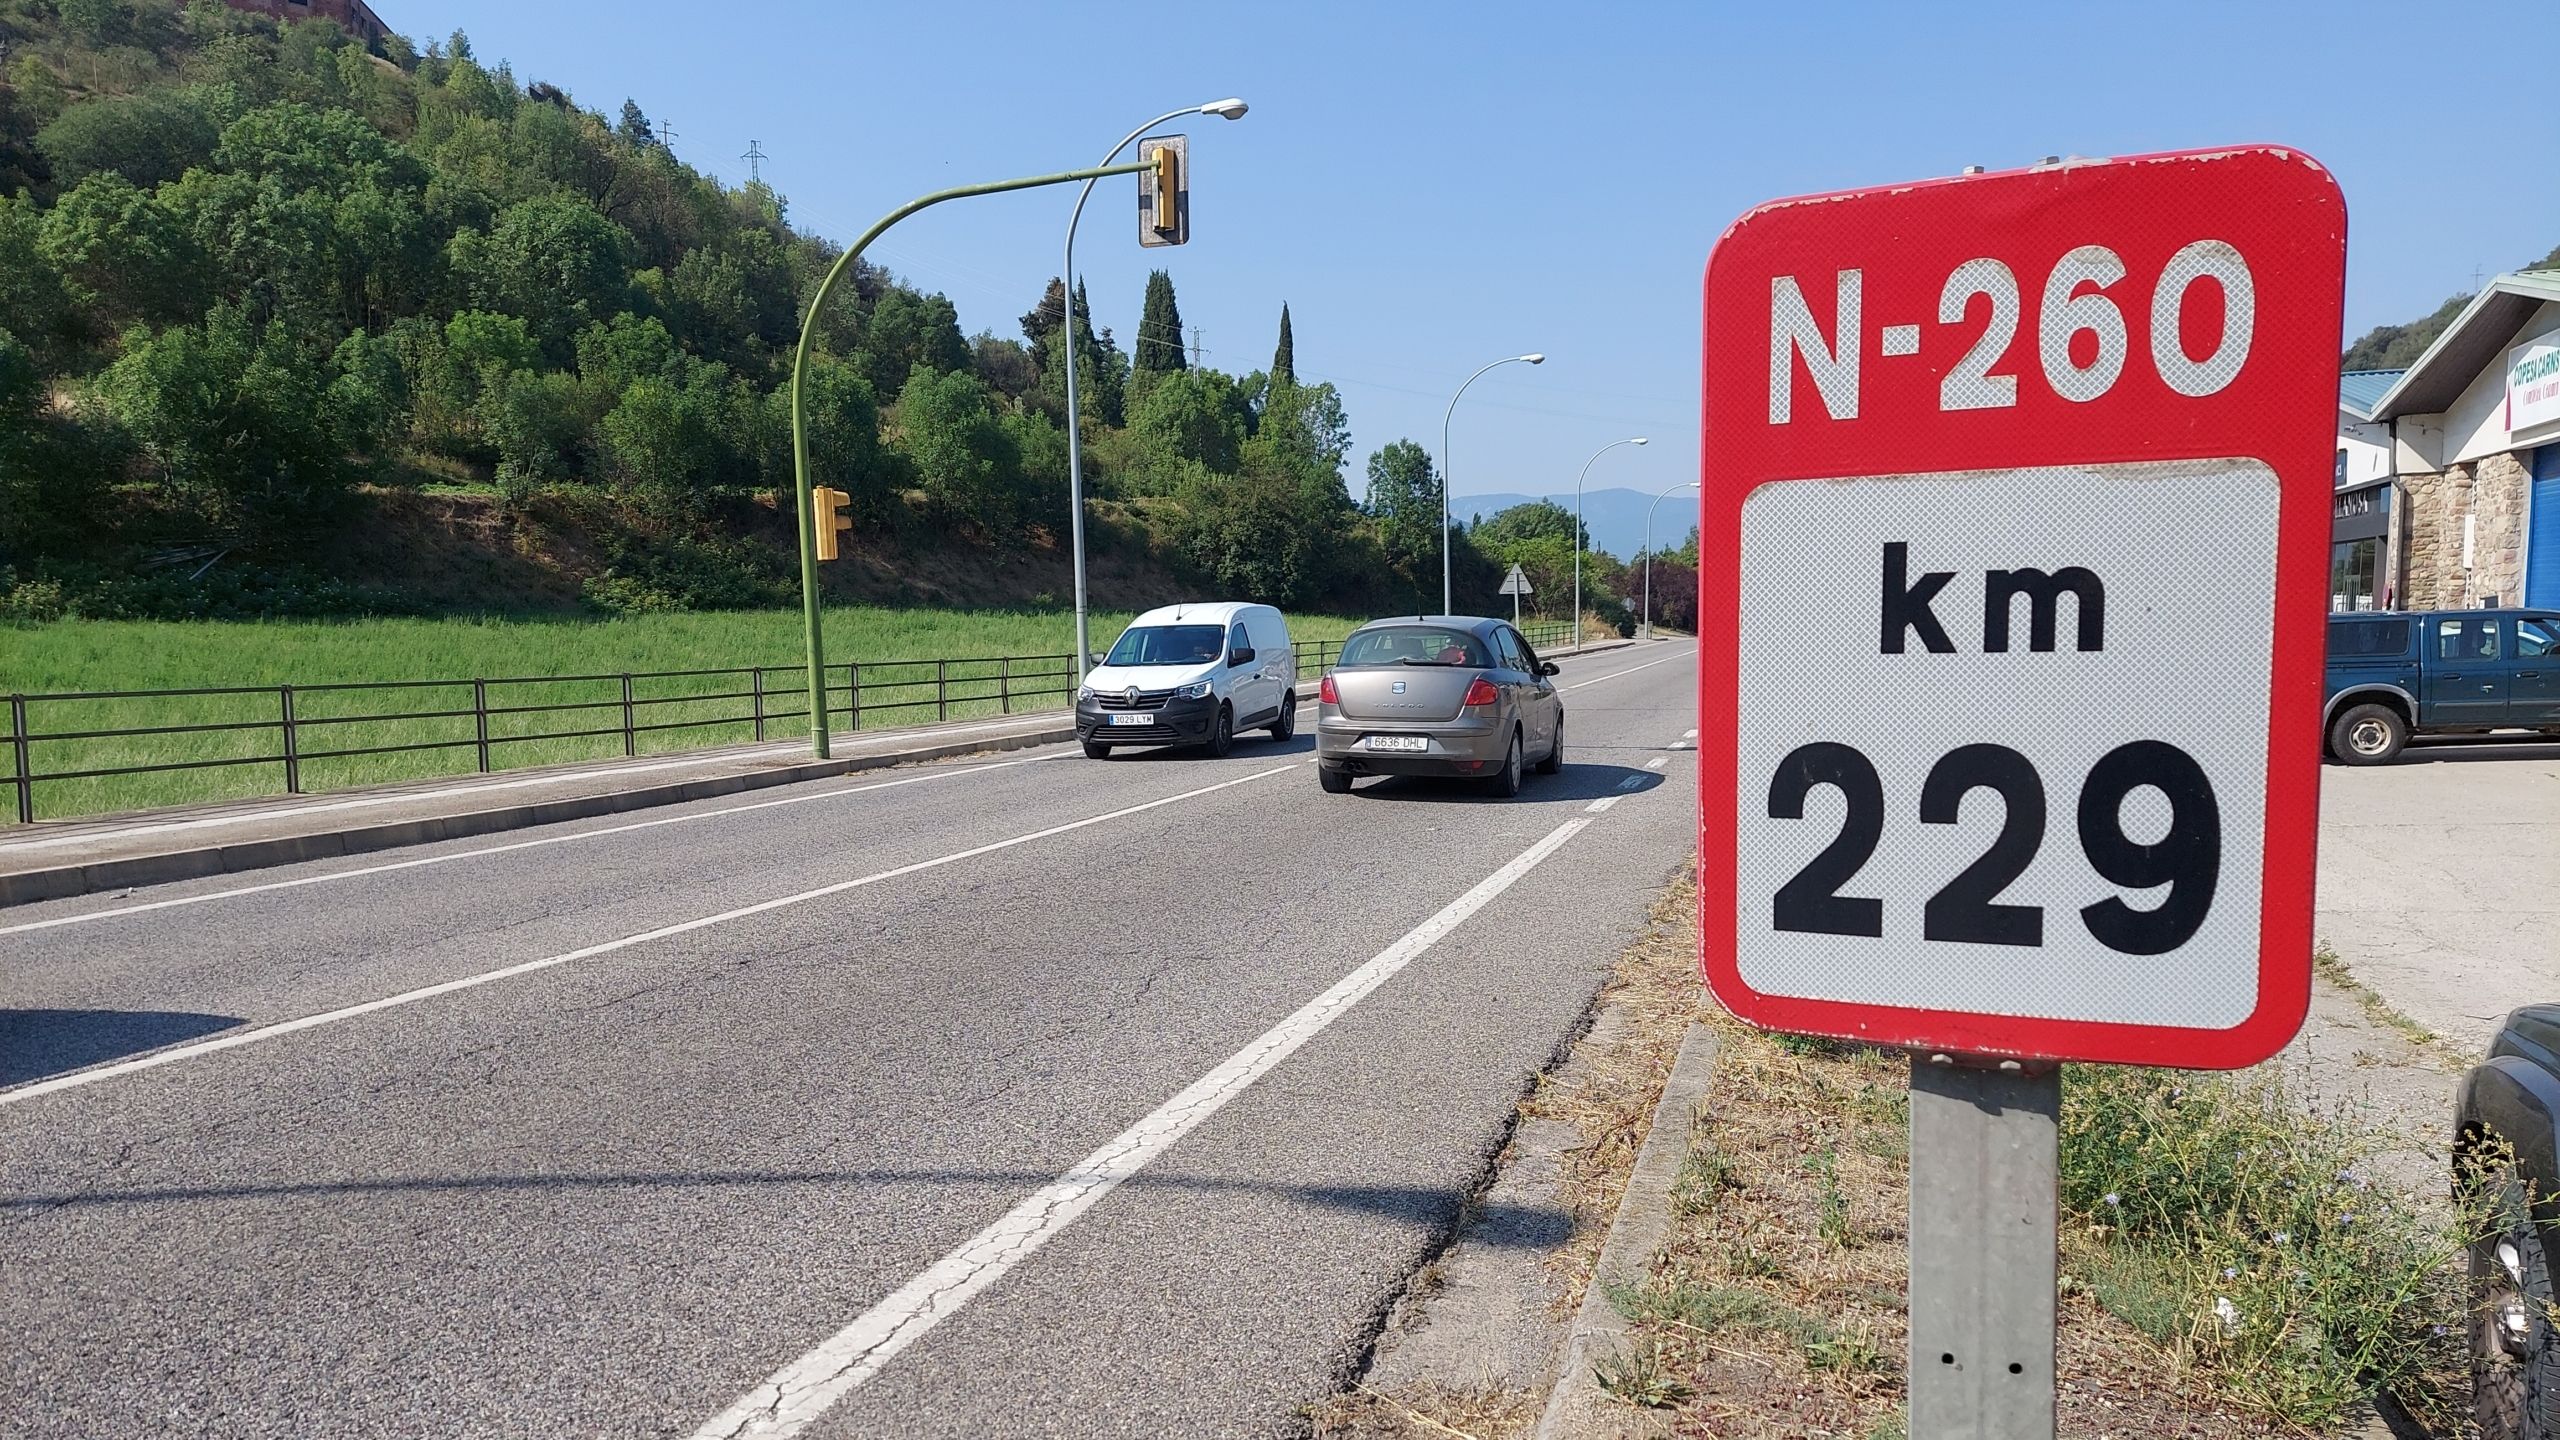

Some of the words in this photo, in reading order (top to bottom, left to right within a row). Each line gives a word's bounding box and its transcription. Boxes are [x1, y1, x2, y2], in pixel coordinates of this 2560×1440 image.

[1769, 239, 2256, 425] N-260
[2514, 358, 2538, 387] COPESA
[1880, 542, 2105, 654] km
[1115, 715, 1134, 724] 3029
[1137, 715, 1152, 724] LYM
[1374, 737, 1400, 747] 6636
[1403, 737, 1422, 748] DHL
[1768, 740, 2221, 955] 229
